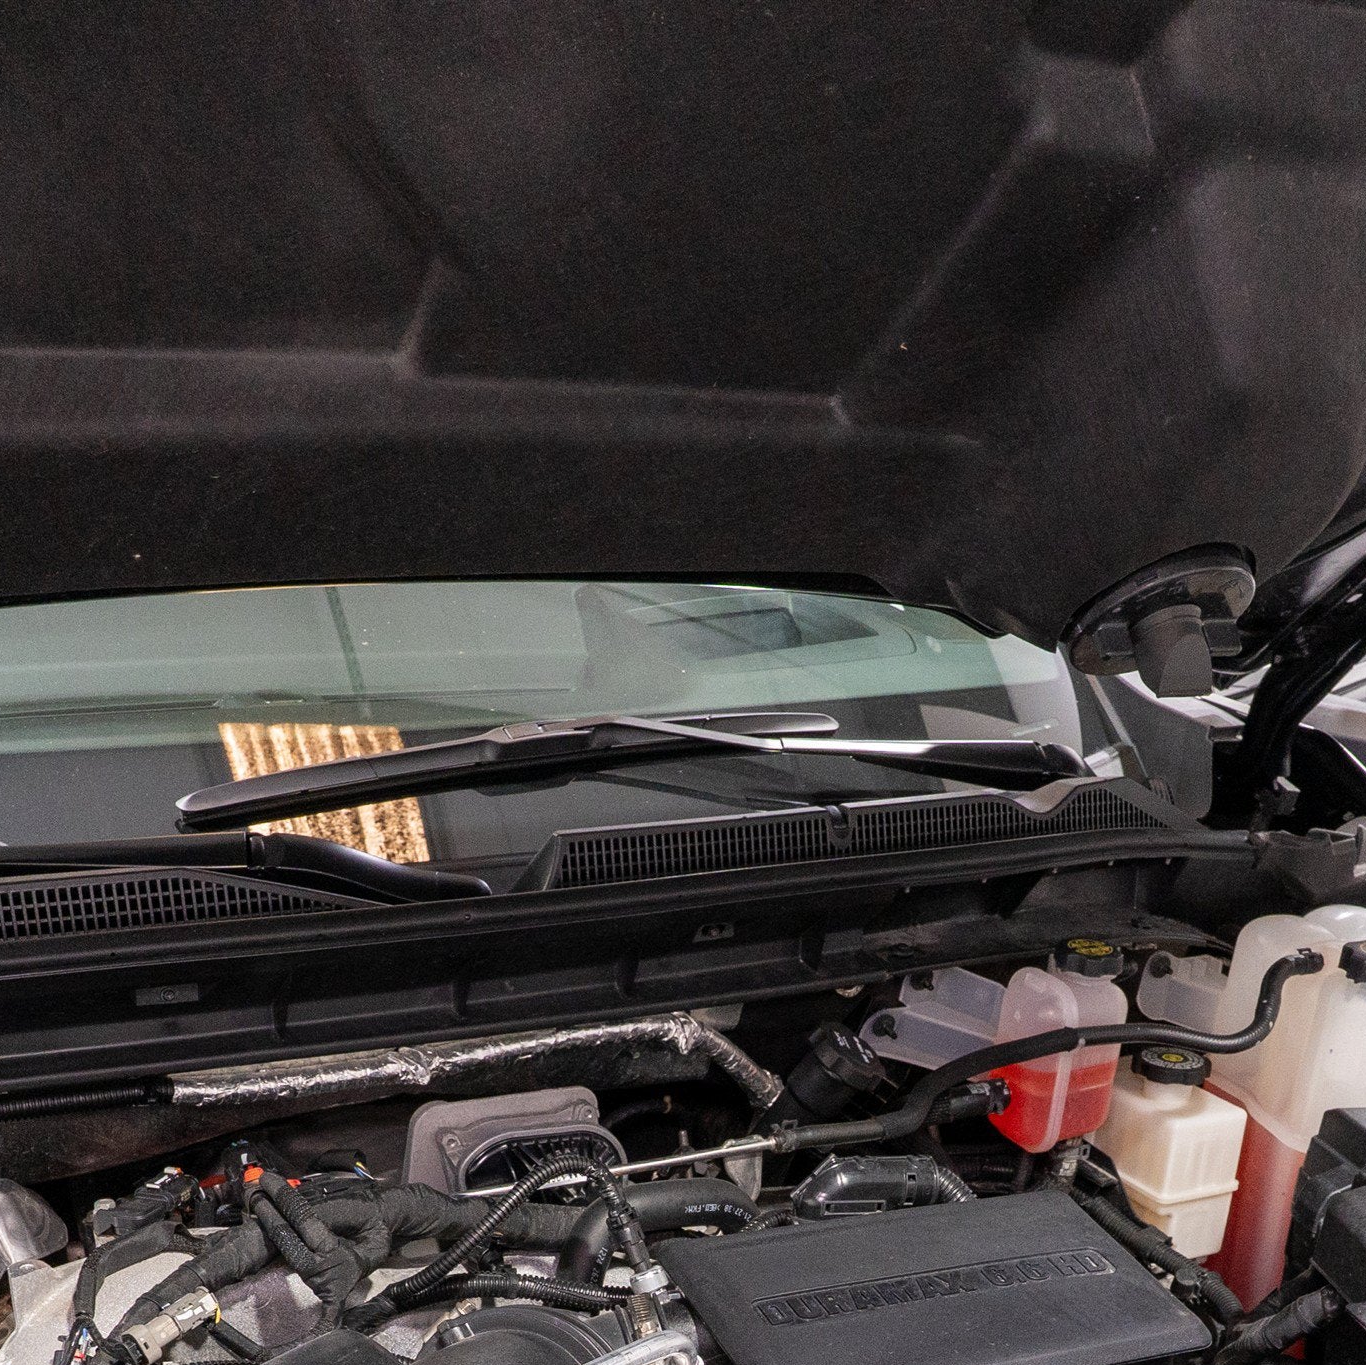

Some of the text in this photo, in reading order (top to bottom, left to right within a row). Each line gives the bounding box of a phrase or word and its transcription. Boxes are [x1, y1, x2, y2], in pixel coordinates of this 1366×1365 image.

[755, 1252, 1111, 1325] DURAMAX 6.6 HD
